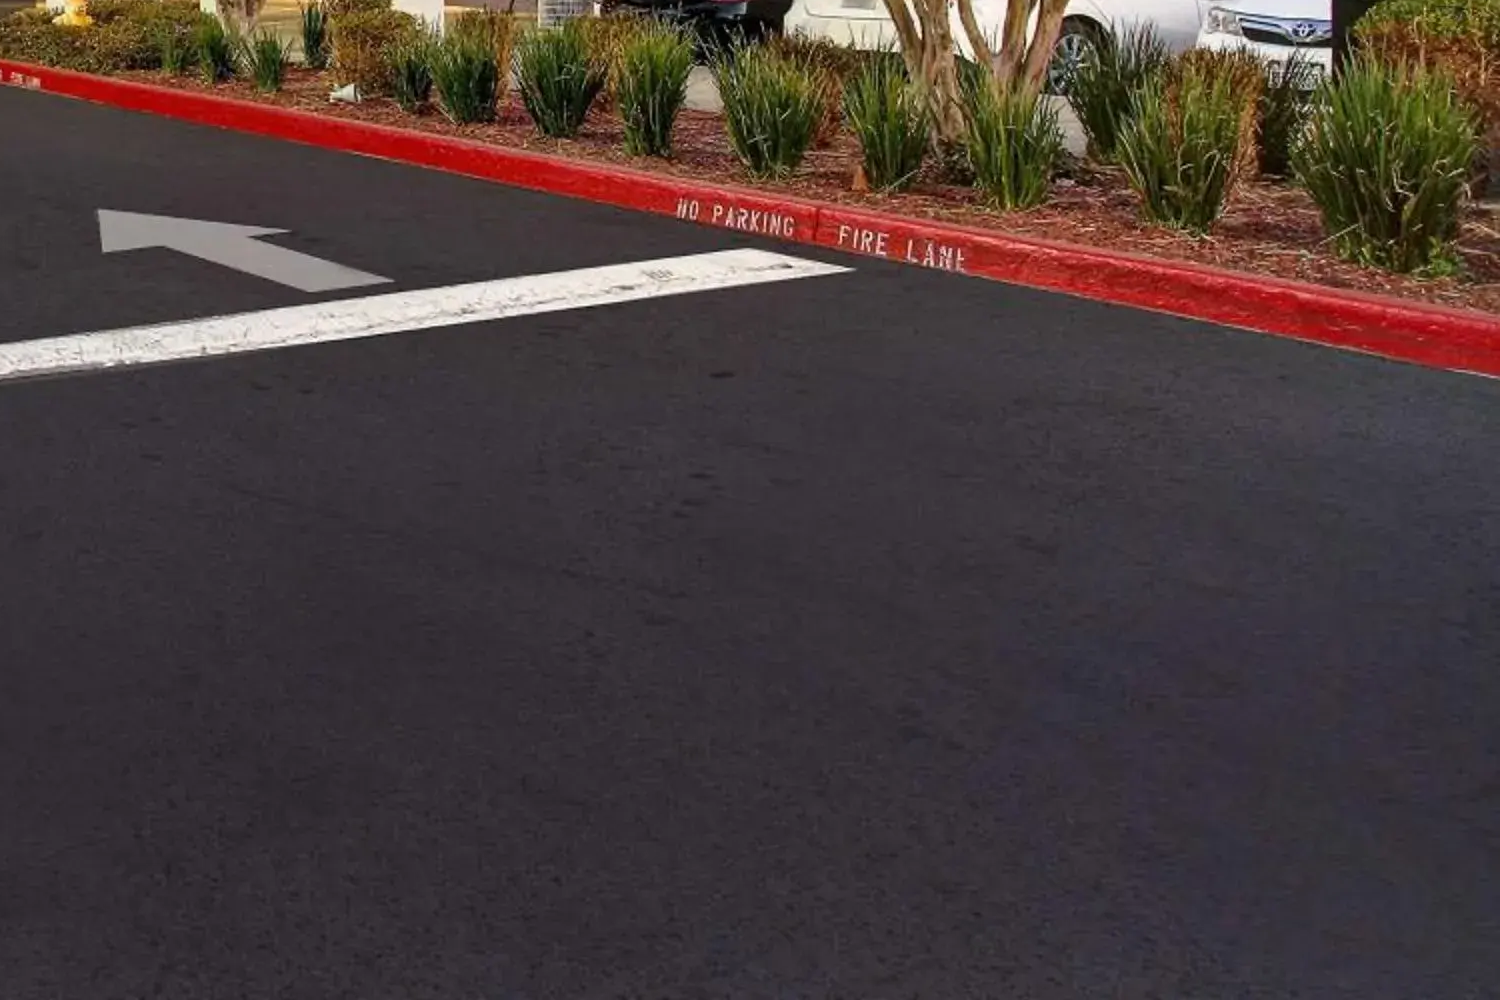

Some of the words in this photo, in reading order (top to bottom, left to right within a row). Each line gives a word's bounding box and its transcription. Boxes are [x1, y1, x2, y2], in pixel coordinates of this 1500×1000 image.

[676, 198, 699, 221] NO
[712, 203, 795, 237] PARKING
[838, 224, 890, 256] FIRE
[905, 238, 967, 273] LANE
